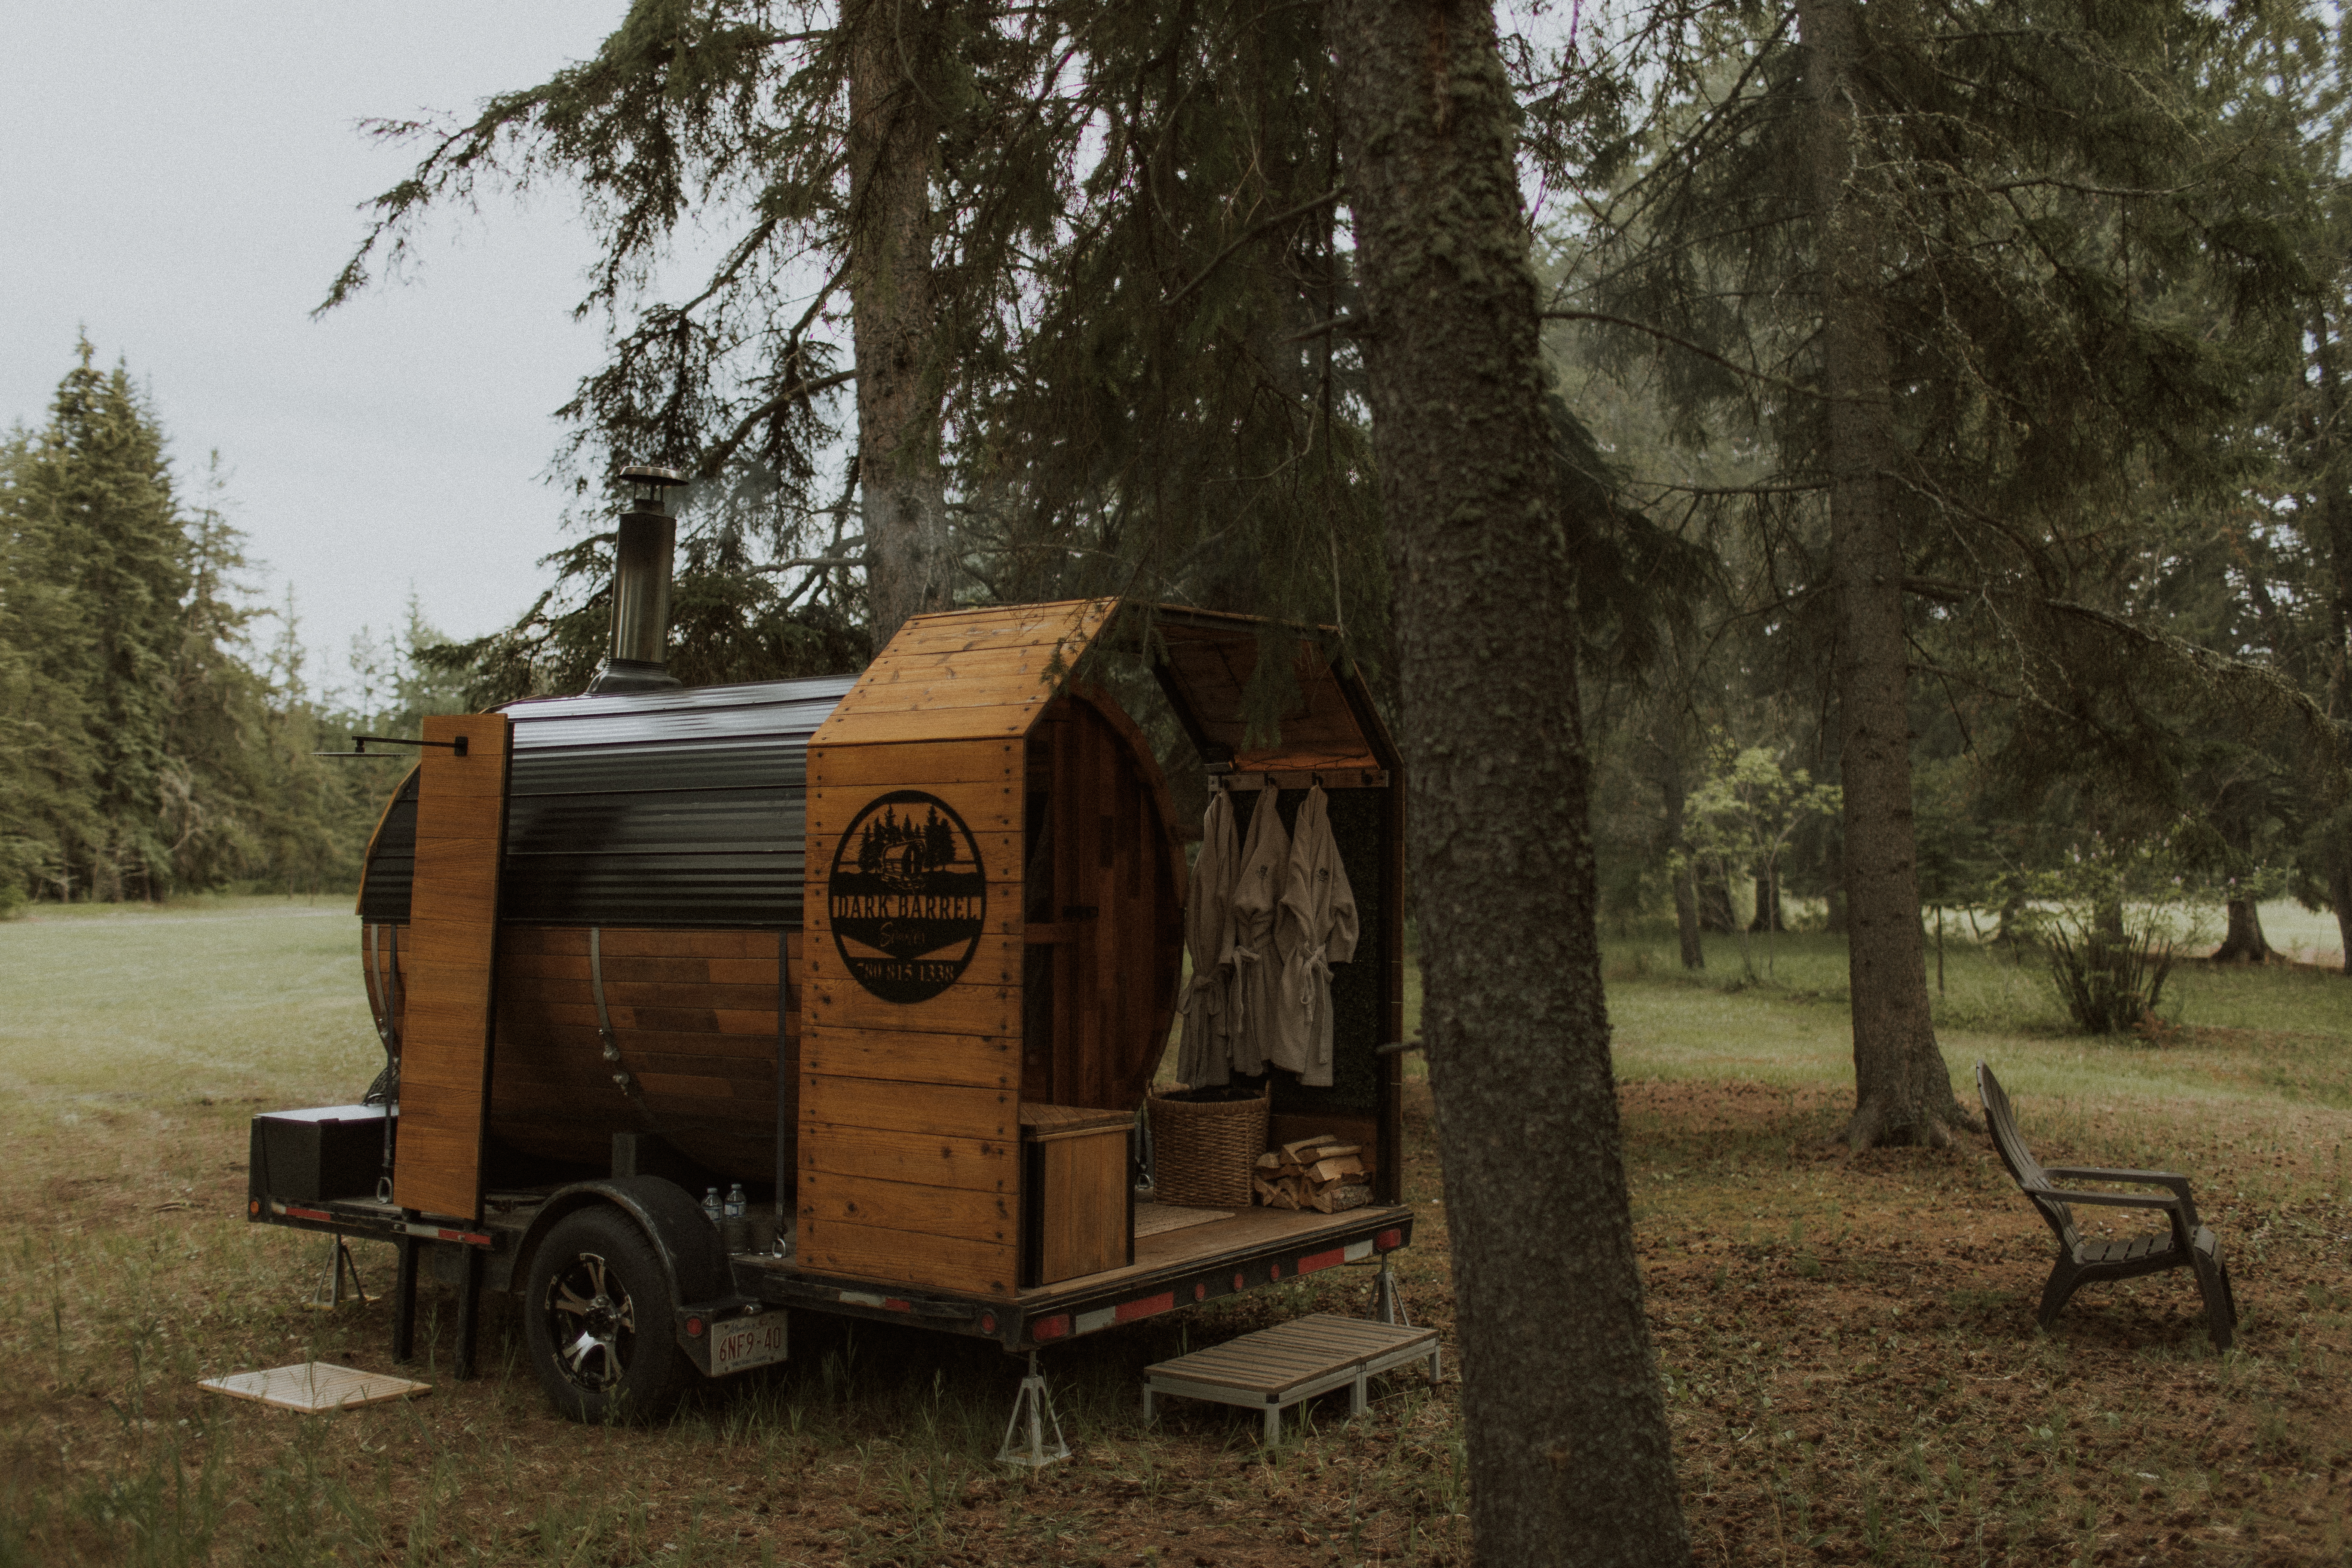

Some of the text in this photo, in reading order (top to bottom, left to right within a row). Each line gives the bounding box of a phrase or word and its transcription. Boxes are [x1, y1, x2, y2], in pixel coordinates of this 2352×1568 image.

[839, 895, 978, 920] DARK BARREL
[886, 964, 913, 981] 815
[920, 964, 954, 983] 1338
[719, 1327, 781, 1361] 6NF9-40
